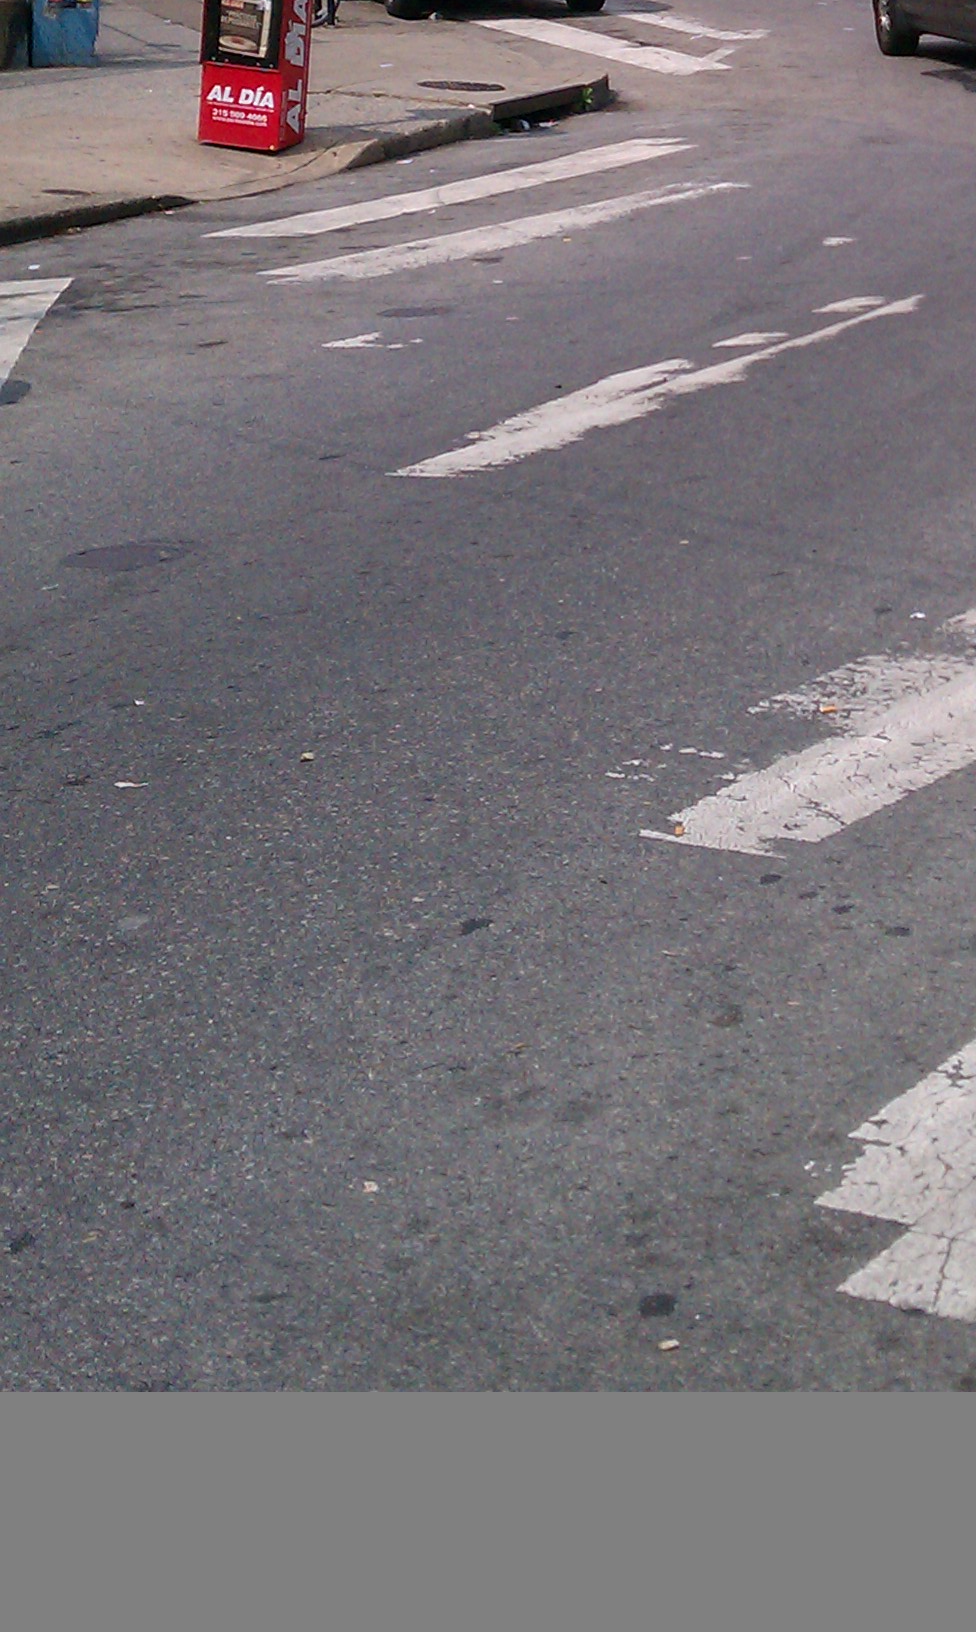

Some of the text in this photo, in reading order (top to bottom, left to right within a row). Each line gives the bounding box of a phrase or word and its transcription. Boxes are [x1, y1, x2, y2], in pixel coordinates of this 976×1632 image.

[206, 84, 235, 104] AL
[238, 86, 275, 109] DÍA
[286, 79, 303, 134] AL
